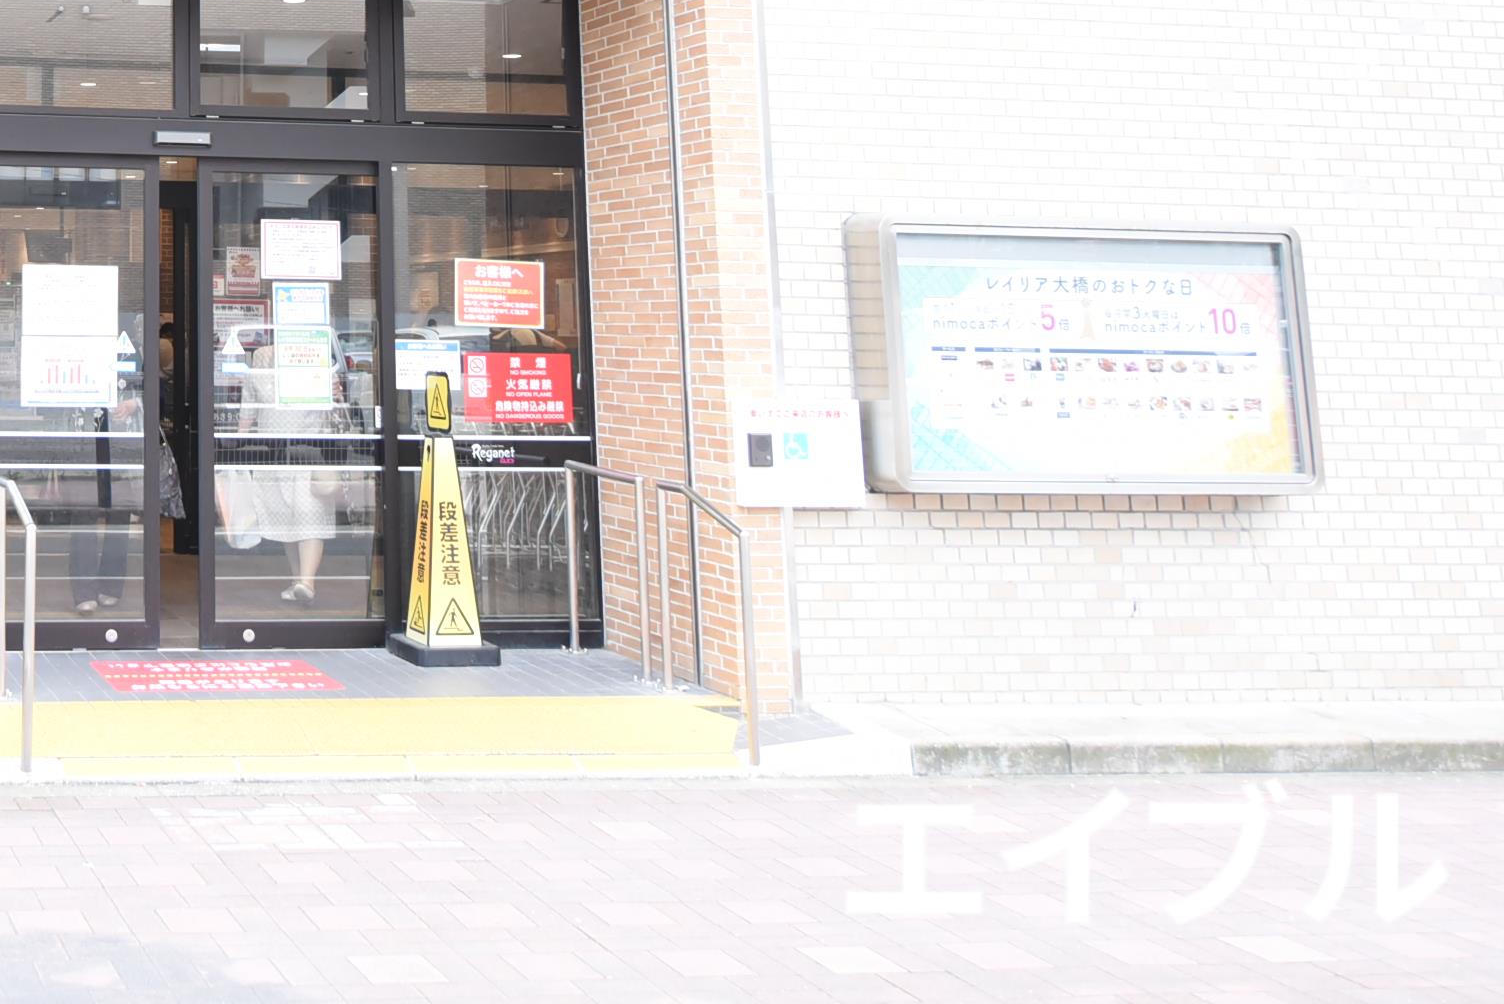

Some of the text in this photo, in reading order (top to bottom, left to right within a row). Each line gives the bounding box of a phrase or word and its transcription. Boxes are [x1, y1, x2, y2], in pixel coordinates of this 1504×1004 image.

[474, 264, 525, 280] お客様へ
[985, 275, 1194, 298] レイリア大橋のおトクな日
[505, 378, 552, 390] 火気厳禁
[471, 443, 515, 463] Reganet
[416, 499, 430, 583] 段差注意
[438, 501, 461, 586] 段差注意
